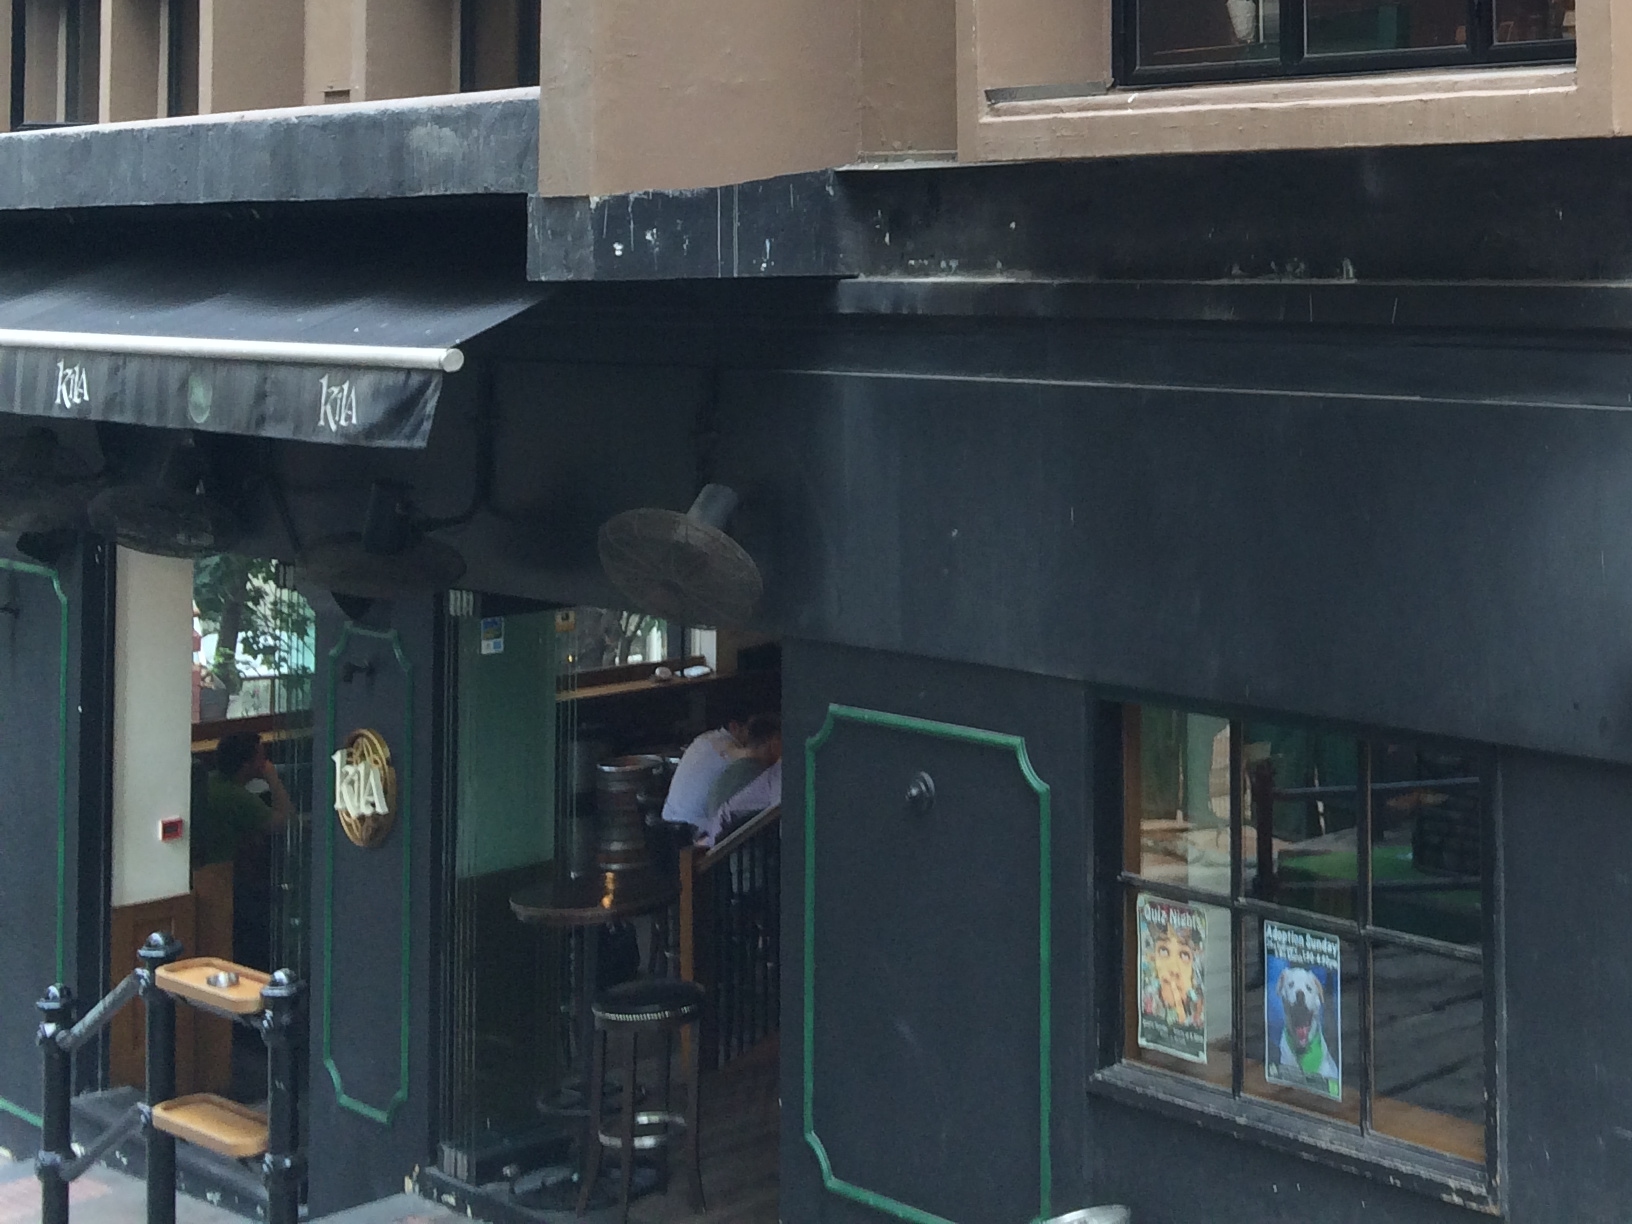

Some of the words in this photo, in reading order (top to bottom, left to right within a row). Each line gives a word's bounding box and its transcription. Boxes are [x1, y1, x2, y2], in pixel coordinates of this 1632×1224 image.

[1143, 903, 1168, 926] Quiz
[1169, 908, 1204, 934] Nights
[1266, 923, 1305, 948] Adoption
[1305, 932, 1338, 958] Sunday
